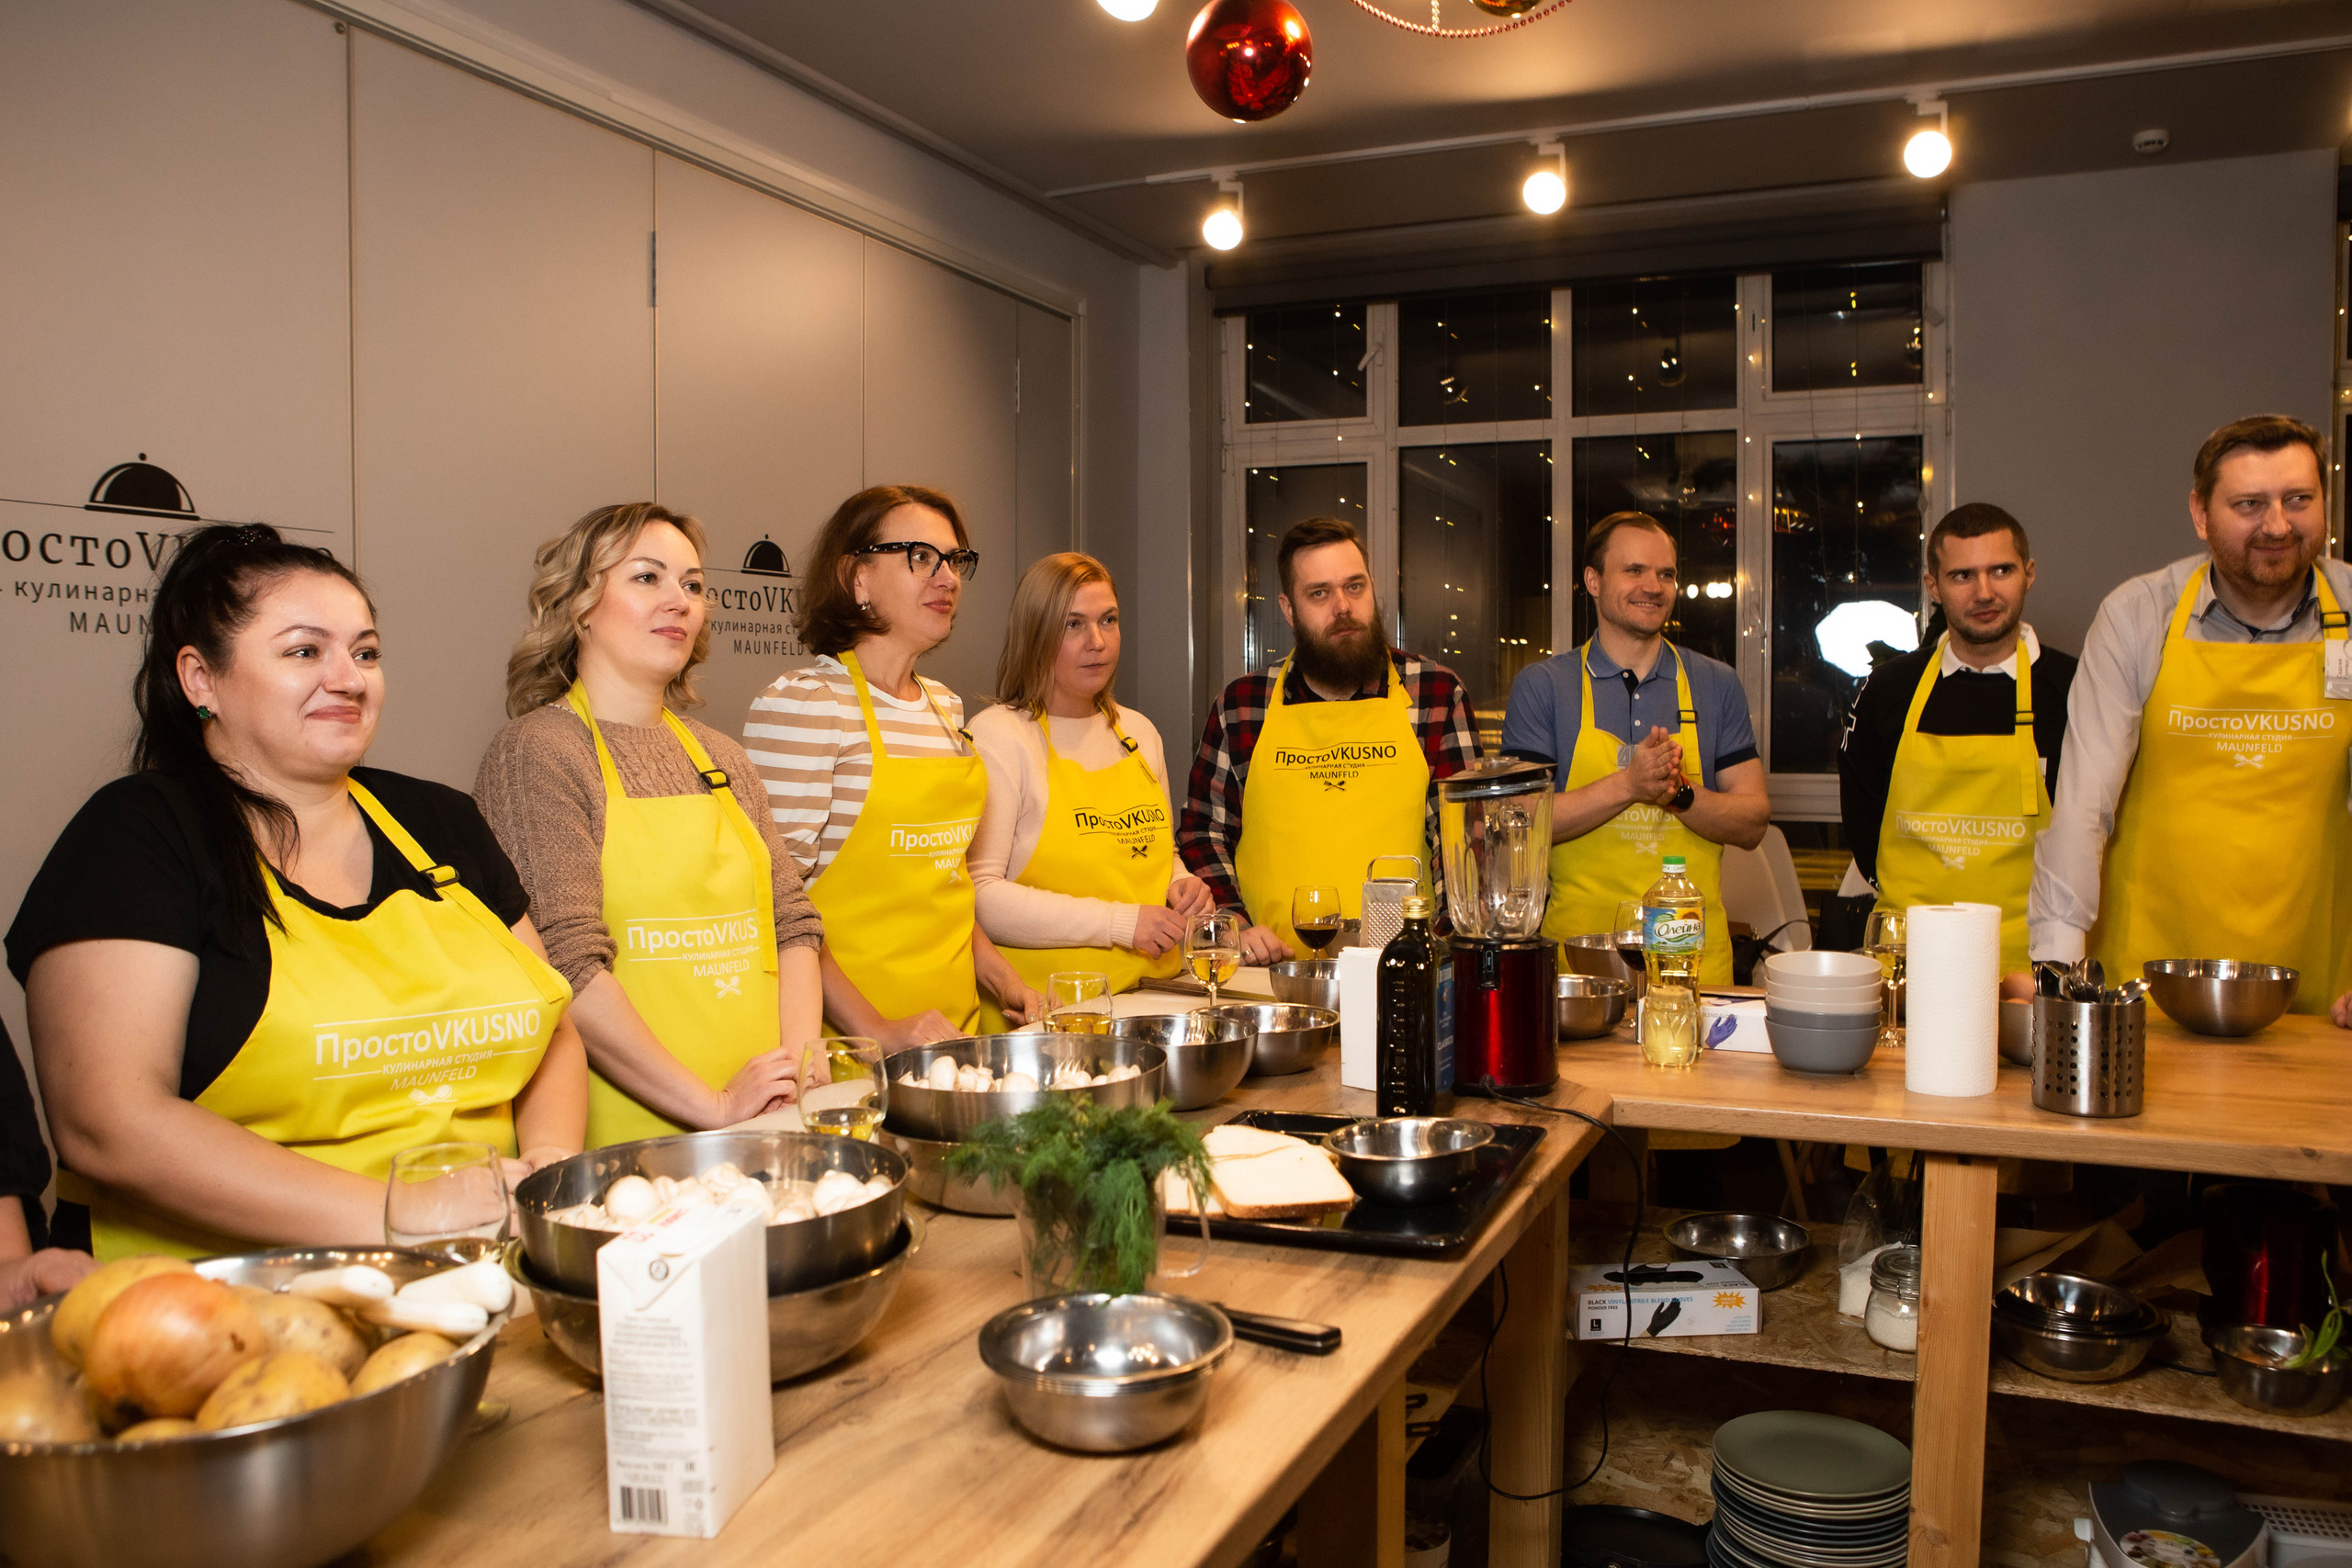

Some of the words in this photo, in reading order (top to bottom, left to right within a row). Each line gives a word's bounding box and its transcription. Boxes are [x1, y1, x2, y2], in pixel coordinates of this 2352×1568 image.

[2, 529, 184, 571] остоV
[707, 585, 796, 614] остоVK
[710, 620, 782, 637] кулинарная
[733, 638, 804, 656] MAUNFELD
[2168, 709, 2335, 731] ПростоVKUSNO
[2208, 732, 2260, 740] КУЛИНАРНАЯ
[1275, 745, 1396, 766] ПростоVKUSNO
[2216, 741, 2282, 753] MAUNFELD
[1309, 771, 1359, 779] MAUNFELD
[1895, 814, 2026, 838] ПростоVKUSNO
[890, 823, 978, 852] ПростоVKU
[1928, 844, 1981, 856] MAUNFELD
[935, 858, 961, 870] MAU
[628, 917, 759, 954] ПростоVKUS
[1657, 922, 1701, 936] Олейна
[682, 949, 731, 962] КУЛИНАРНАЯ
[732, 945, 754, 956] СТУДИЯ
[694, 958, 750, 977] MAUNFELD
[316, 1009, 540, 1068] ПростоVKUSNO
[382, 1055, 452, 1076] КУЛИНАРНАЯ
[455, 1049, 492, 1065] СТУДИЯ
[390, 1065, 477, 1090] MAUNFELD
